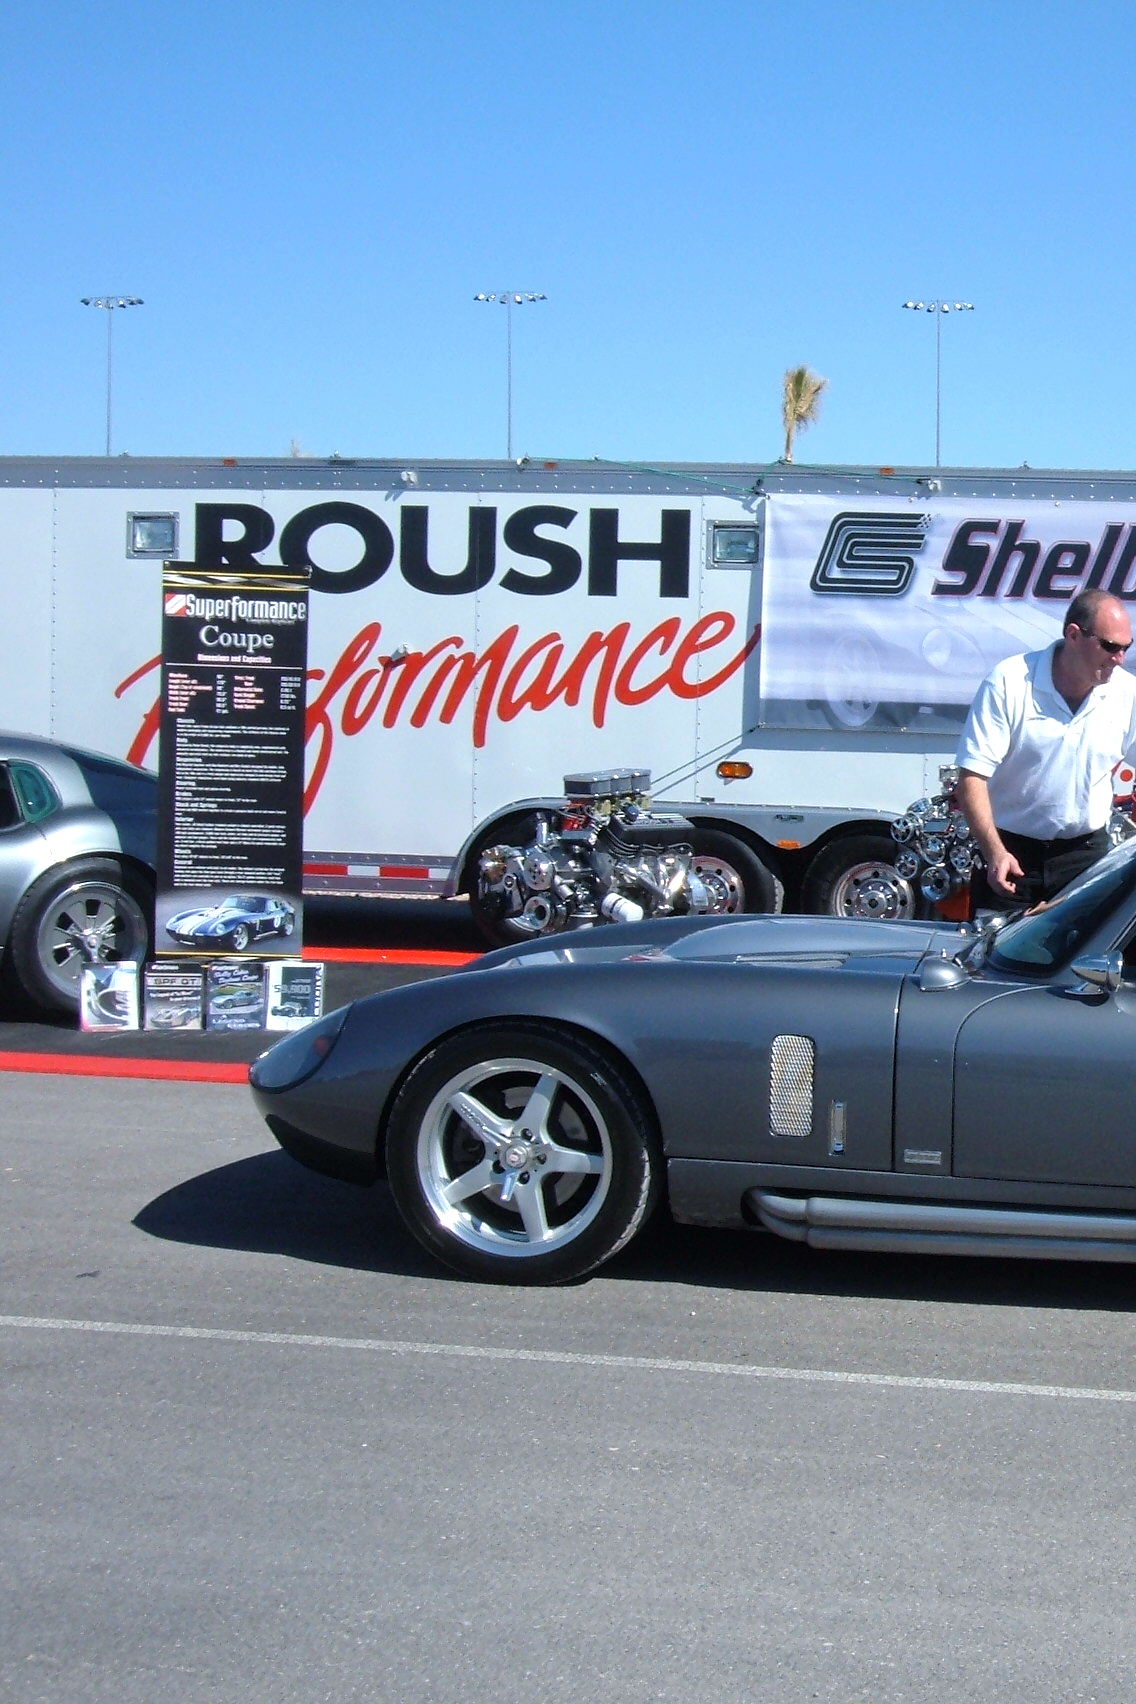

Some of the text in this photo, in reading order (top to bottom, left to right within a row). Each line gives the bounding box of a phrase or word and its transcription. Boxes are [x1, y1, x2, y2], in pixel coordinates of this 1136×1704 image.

[194, 500, 692, 599] ROUSH
[186, 593, 307, 623] Superformance
[200, 625, 275, 653] Coupe
